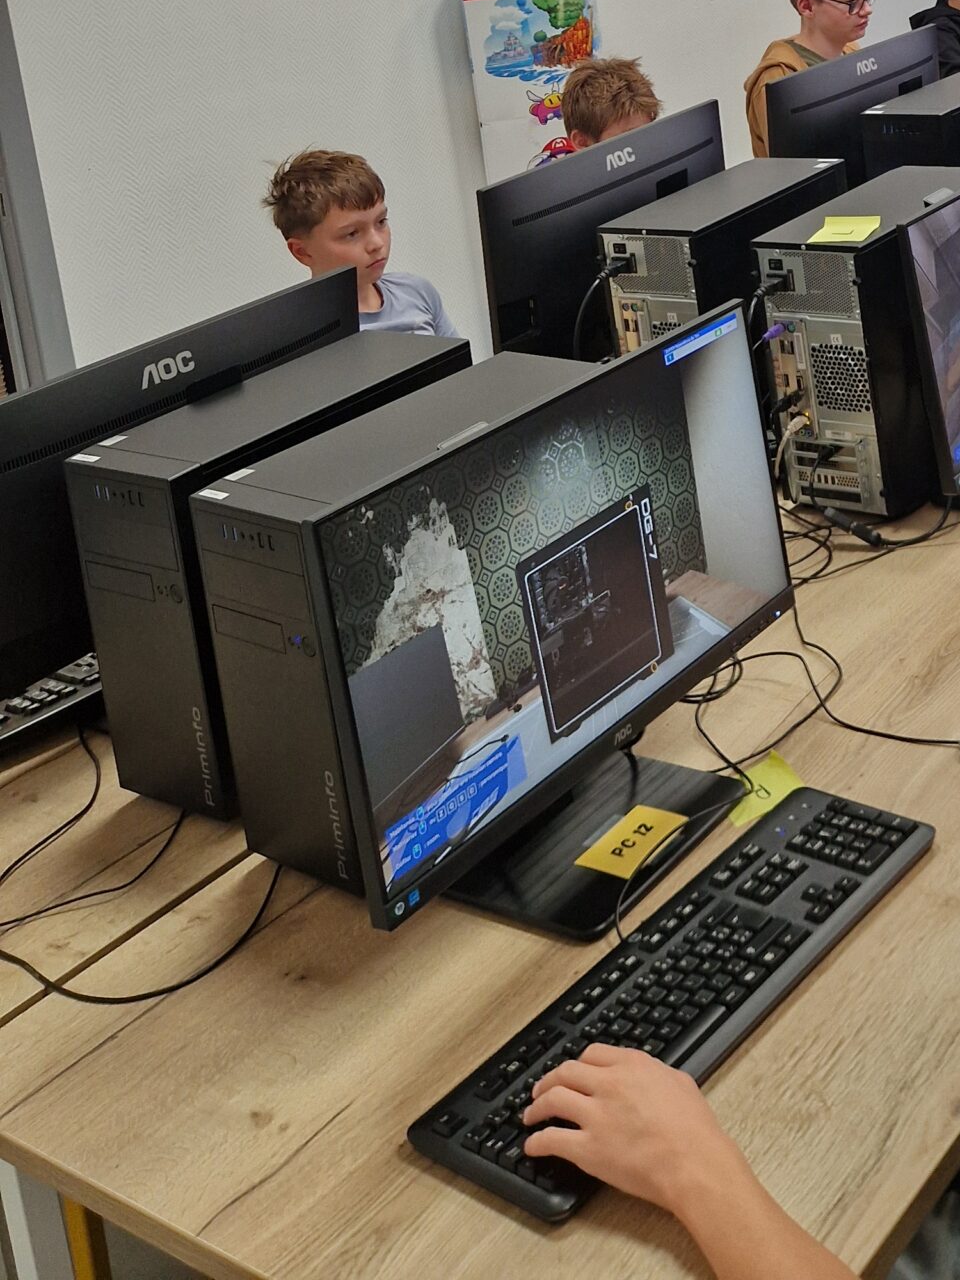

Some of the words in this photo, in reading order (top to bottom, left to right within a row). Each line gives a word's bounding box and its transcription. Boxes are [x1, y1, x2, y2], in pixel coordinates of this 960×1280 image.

[857, 57, 878, 76] AOC
[606, 147, 636, 171] AOC
[142, 350, 195, 390] AOC
[614, 723, 633, 745] AOC
[610, 838, 636, 857] PC
[633, 823, 654, 836] 12
